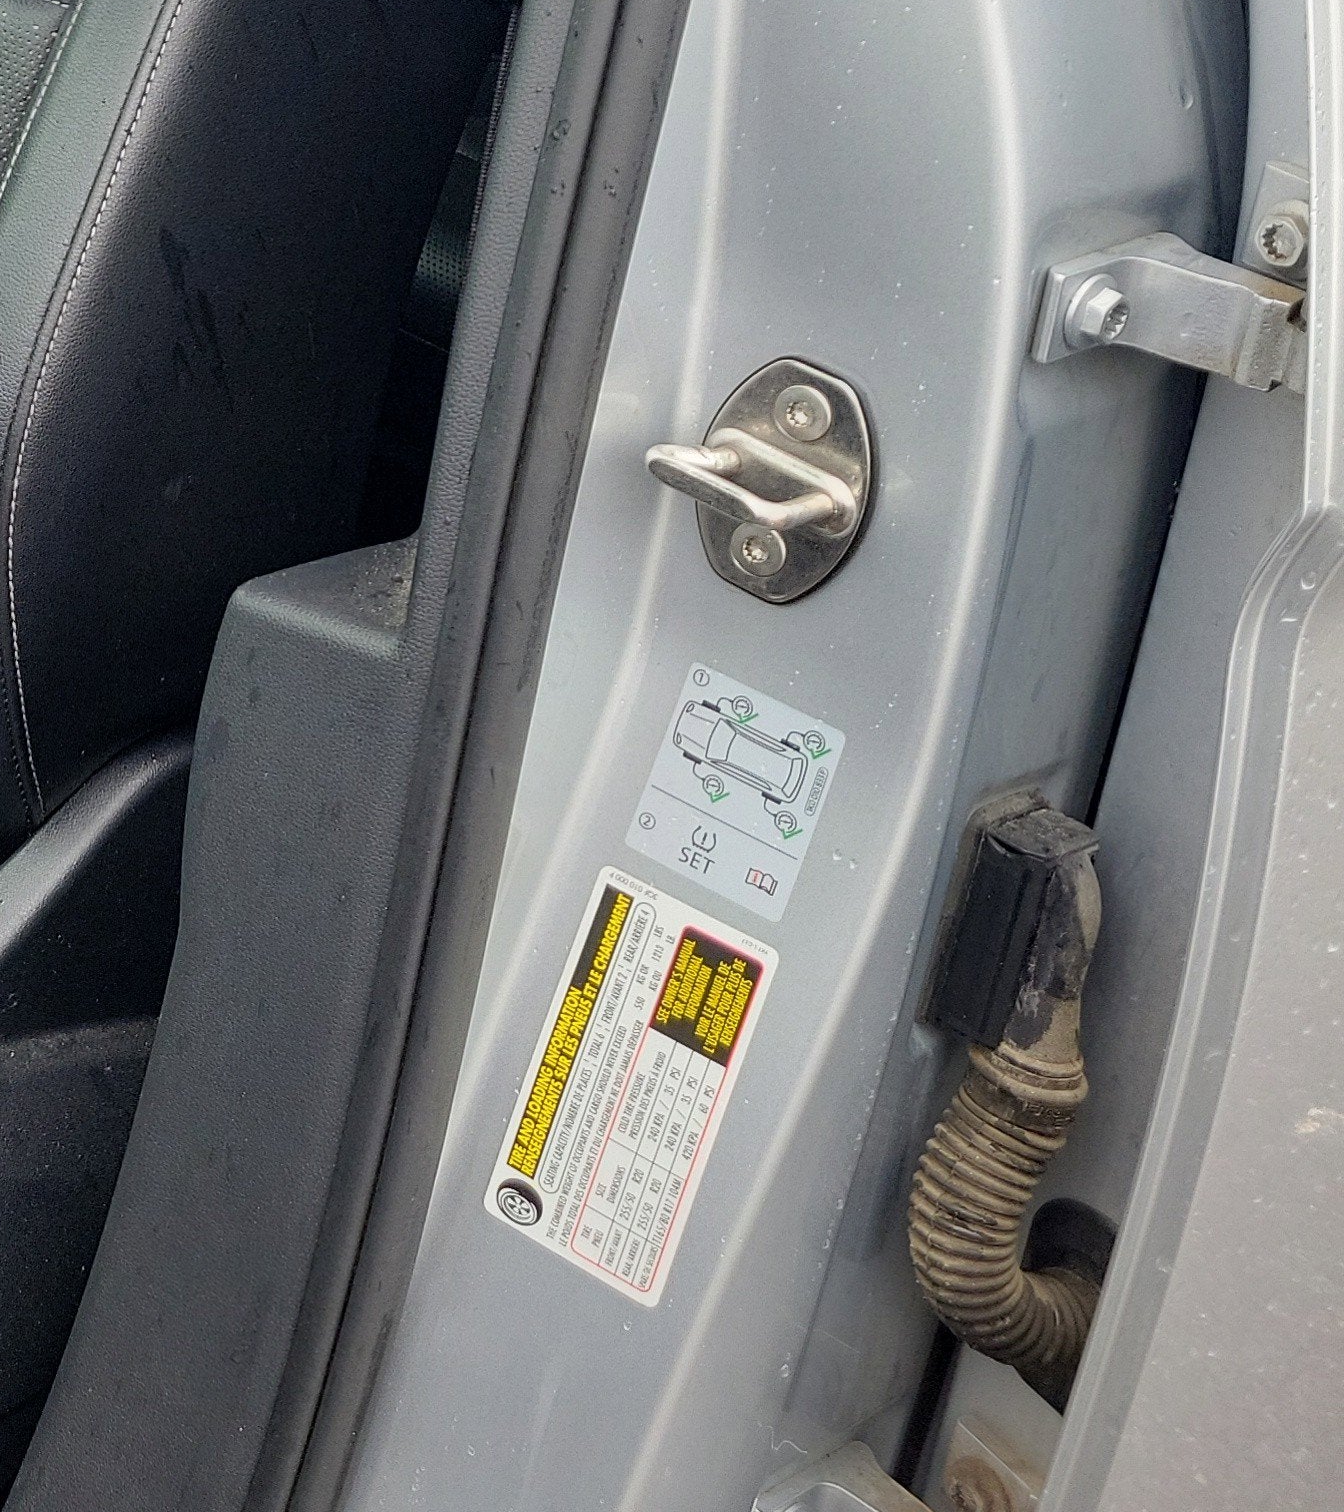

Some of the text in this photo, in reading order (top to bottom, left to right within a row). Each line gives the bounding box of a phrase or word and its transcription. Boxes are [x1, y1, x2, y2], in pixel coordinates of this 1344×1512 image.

[678, 846, 715, 874] SET
[639, 908, 649, 916] 4
[653, 924, 664, 938] LBS
[636, 973, 646, 985] KG
[648, 979, 658, 991] KG
[655, 936, 696, 1023] SEE OWNER'S MANUAL
[671, 952, 703, 1019] FOR ADDITIONAL
[601, 971, 627, 1024] FRONT/AVANT 2
[684, 963, 712, 1020] INFORMATION
[694, 960, 731, 1038] VOIR LE MANUEL DE
[702, 956, 746, 1054] L'USAGER POUR PLUS DE
[719, 976, 753, 1047] RENSEIGNEMENTS
[520, 892, 631, 1176] RENSEIGNEMENTS SUR LES PNEUS ET LE CHARGEMENT
[588, 1031, 605, 1059] TOTAL 6
[508, 985, 582, 1169] TIRE AND LOADING INFORMATION
[613, 1071, 624, 1088] DOIT
[669, 1066, 681, 1080] PSI
[686, 1075, 698, 1089] PSI
[609, 1087, 619, 1097] NE
[628, 1108, 645, 1140] PRESSION
[638, 1095, 650, 1110] DES
[652, 1050, 666, 1072] FROID
[663, 1083, 675, 1096] 35
[680, 1092, 692, 1105] 35
[703, 1084, 715, 1098] PSI
[616, 1071, 645, 1133] COLD TIRE PRESSURE
[697, 1102, 709, 1114] 60
[595, 1095, 616, 1137] CHARGEMENT
[652, 1111, 665, 1127] KPA
[543, 1066, 592, 1188] SEATING CAPACITY/NOMBRE DE PLACES
[546, 1024, 627, 1240] THE COMBINED WEIGHT OF OCCUPANTS AND CARGO SHOULD NEVER EXCEED
[646, 1125, 660, 1142] 240
[668, 1119, 682, 1136] KPA
[592, 1135, 602, 1147] DU
[663, 1134, 677, 1152] 240
[686, 1129, 699, 1146] KPA
[589, 1145, 599, 1155] ET
[680, 1143, 694, 1161] 420
[577, 1153, 596, 1189] OCCUPANTS
[631, 1167, 644, 1185] R20
[594, 1182, 606, 1198] SIZE
[606, 1164, 626, 1204] DIMENSIONS
[649, 1176, 662, 1194] R20
[668, 1177, 682, 1199] 104M
[573, 1188, 584, 1202] DES
[567, 1200, 580, 1220] TOTAL
[619, 1191, 636, 1221] 255/50
[663, 1198, 675, 1214] R17
[636, 1201, 653, 1231] 255/50
[560, 1218, 574, 1239] POIDS
[580, 1224, 592, 1239] TIRE
[652, 1212, 670, 1245] T165/80
[558, 1236, 567, 1247] LE
[591, 1228, 604, 1248] PNEU
